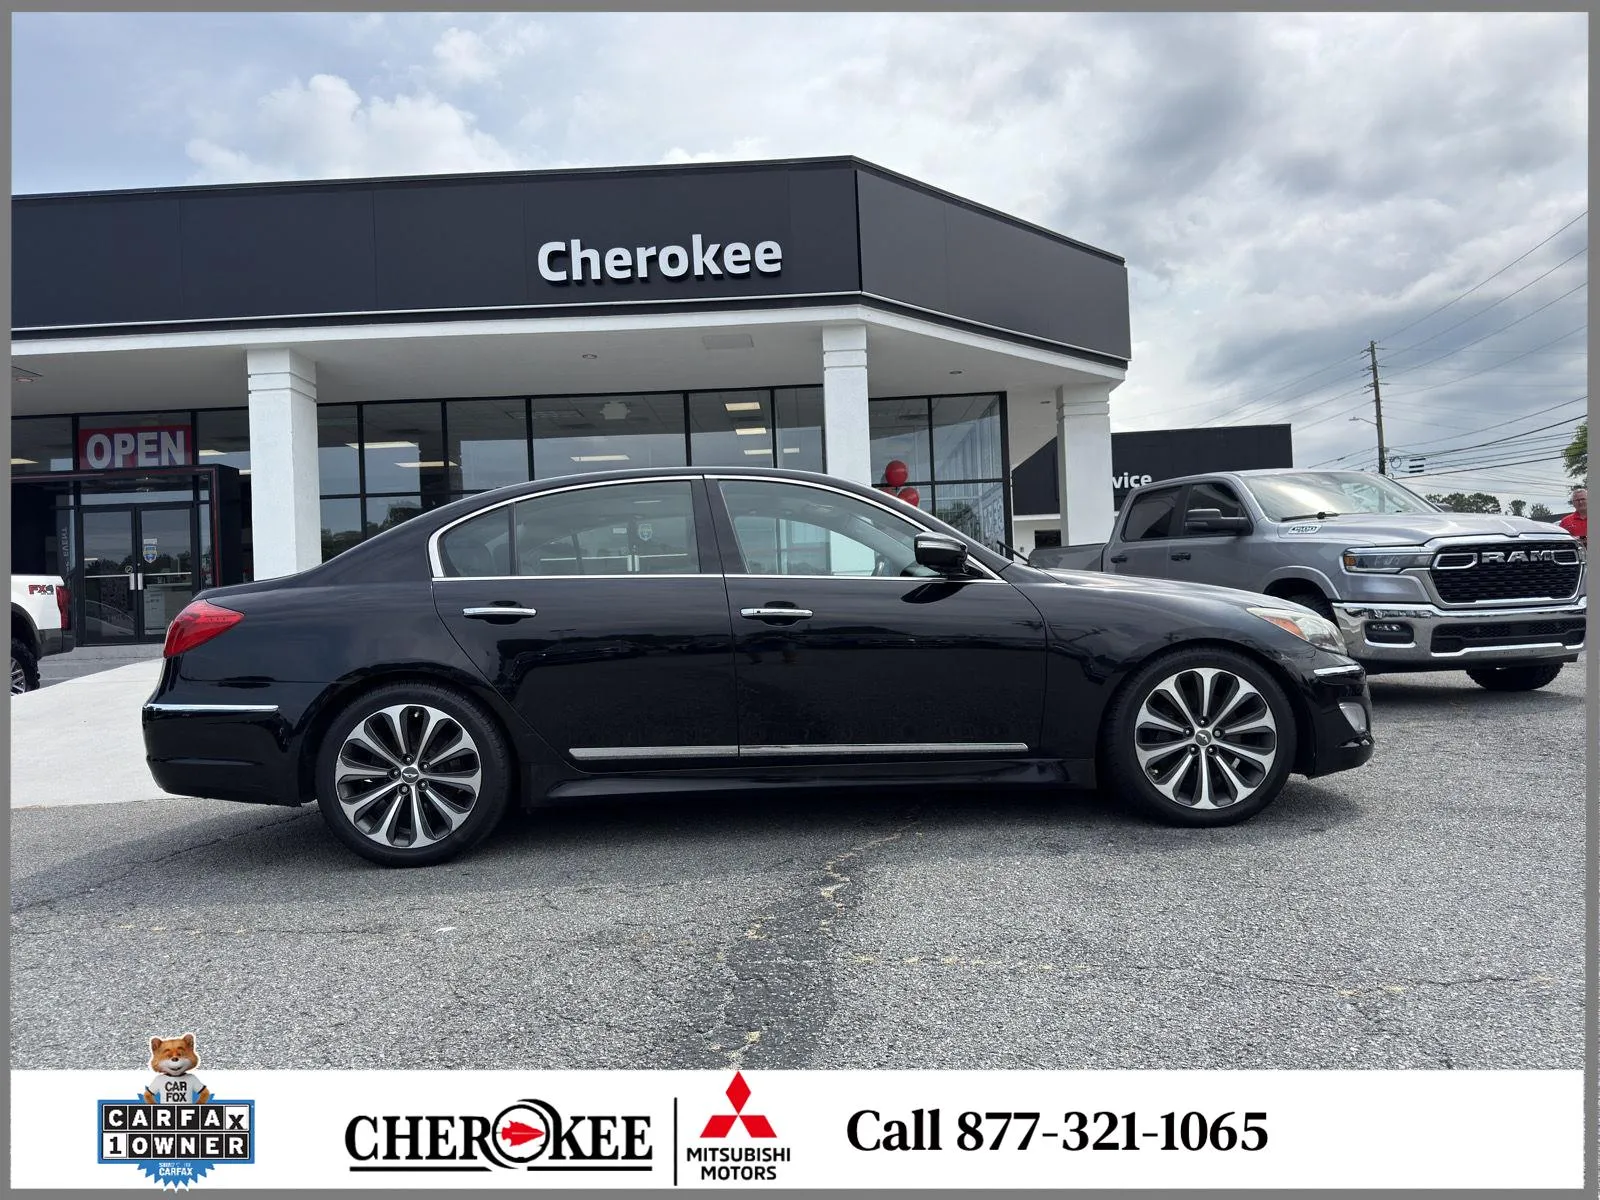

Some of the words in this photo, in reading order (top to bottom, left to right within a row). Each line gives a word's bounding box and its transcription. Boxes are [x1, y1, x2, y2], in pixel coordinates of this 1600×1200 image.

[537, 233, 783, 282] Cherokee
[86, 430, 185, 469] OPEN
[1481, 549, 1555, 563] RAM
[28, 584, 55, 595] FX4
